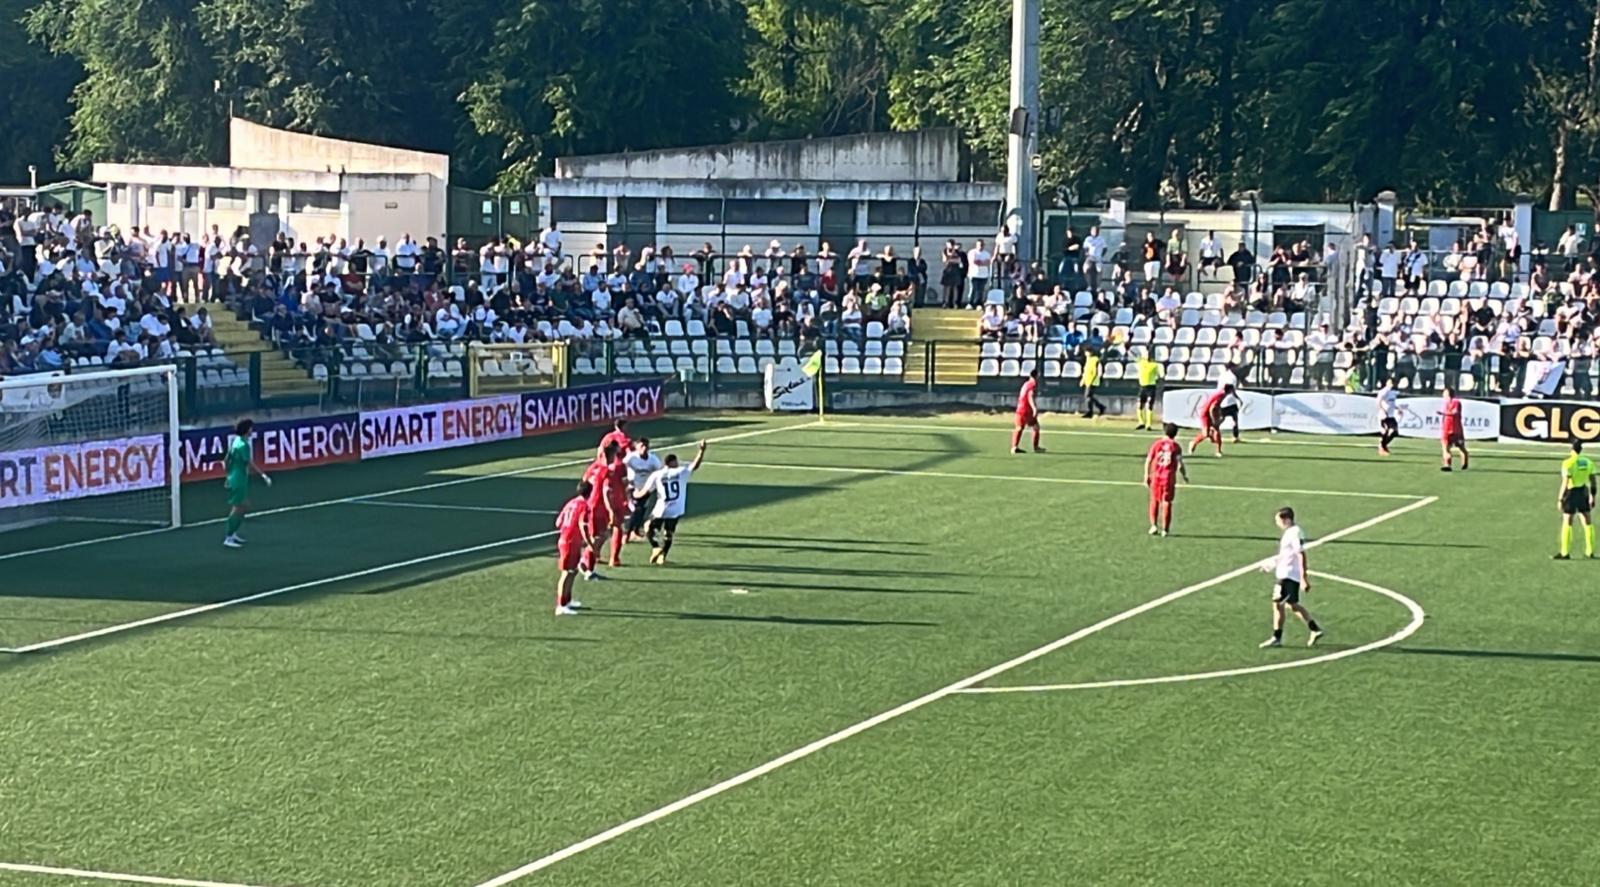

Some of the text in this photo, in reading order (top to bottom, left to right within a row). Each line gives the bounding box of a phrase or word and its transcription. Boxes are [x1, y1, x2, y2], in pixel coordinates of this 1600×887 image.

[361, 402, 518, 451] SMART ENERGY
[523, 385, 662, 430] SMART ENERGY
[1515, 405, 1600, 439] GLG
[263, 421, 358, 464] ENERGY
[43, 445, 159, 493] ENERGY
[662, 480, 680, 502] 19
